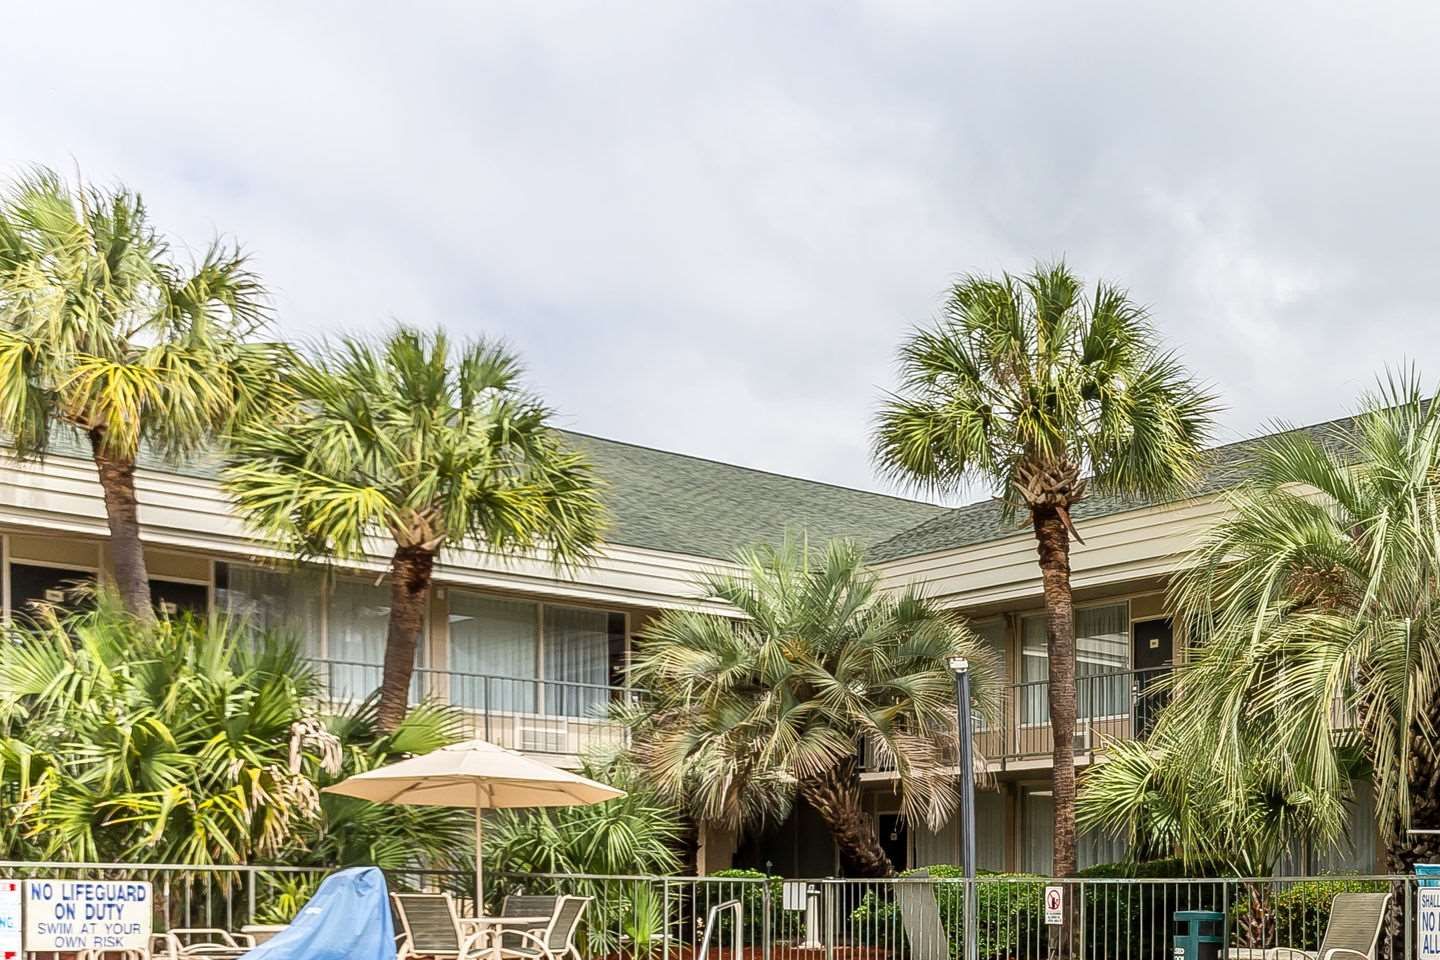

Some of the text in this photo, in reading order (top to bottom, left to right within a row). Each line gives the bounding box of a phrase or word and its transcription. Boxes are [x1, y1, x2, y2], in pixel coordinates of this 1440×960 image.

[31, 883, 147, 901] NO LIFEGUARD
[55, 902, 125, 920] ON DUTY
[38, 922, 141, 935] SWIM AT YOUR
[1422, 911, 1435, 932] NO
[55, 936, 124, 948] OWN RISK
